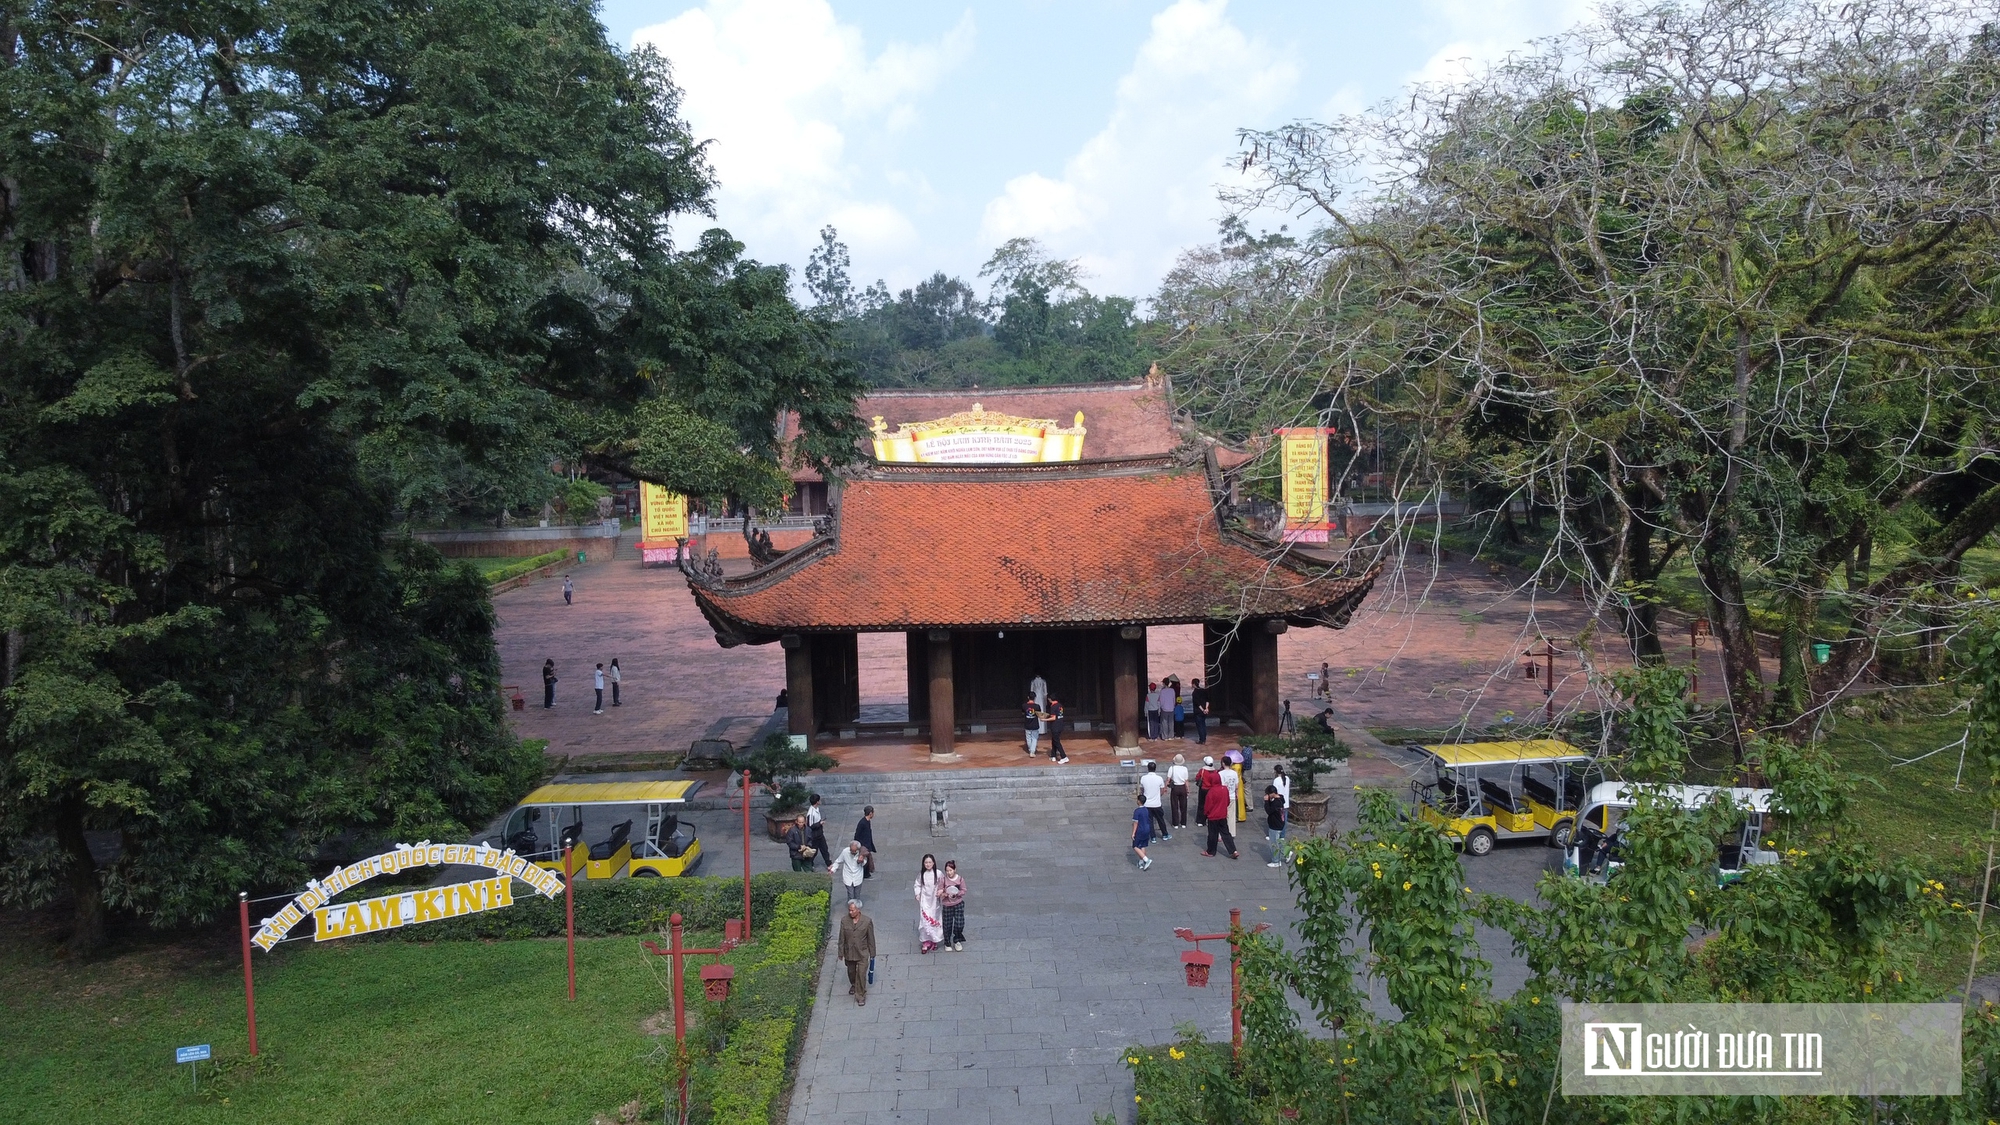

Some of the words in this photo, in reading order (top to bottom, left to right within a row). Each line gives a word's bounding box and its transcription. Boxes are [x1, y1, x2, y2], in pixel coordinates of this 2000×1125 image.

[255, 905, 303, 951] KHU
[300, 886, 327, 912] DI
[323, 867, 376, 895] TÍCH
[380, 840, 441, 874] QUỐC
[443, 845, 477, 864] GIA
[483, 846, 526, 876] ĐẶC
[521, 865, 564, 898] BIỆT
[314, 896, 403, 941] LAM
[413, 876, 513, 923] KINH
